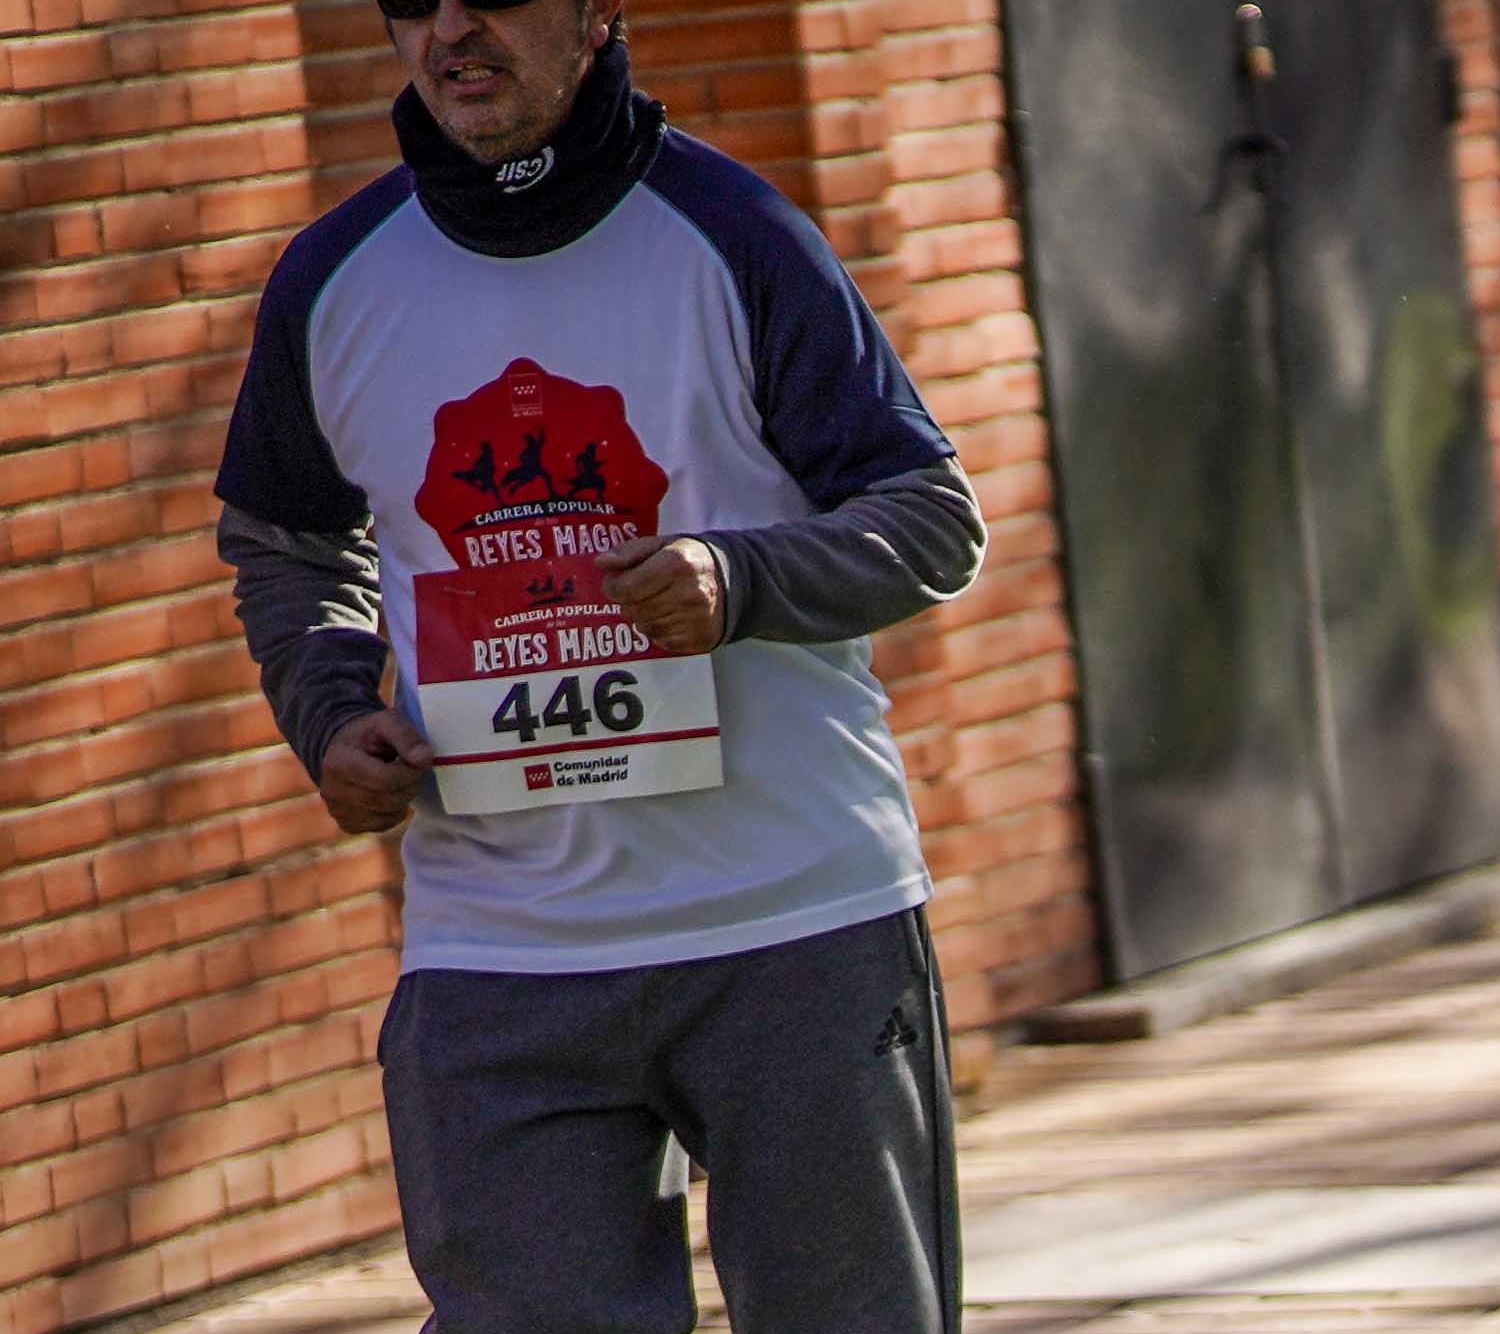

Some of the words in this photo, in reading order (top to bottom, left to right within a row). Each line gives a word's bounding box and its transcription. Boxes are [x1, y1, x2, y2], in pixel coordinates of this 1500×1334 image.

[475, 503, 544, 526] CARRERA
[548, 501, 615, 514] POPULAR
[464, 529, 543, 568] REYES
[494, 608, 553, 628] CARRERA
[556, 603, 621, 618] POPULAR
[472, 632, 549, 673] REYES
[492, 669, 645, 743] 446
[554, 755, 629, 772] Comunidad
[557, 772, 575, 786] de
[579, 769, 628, 784] Madrid
